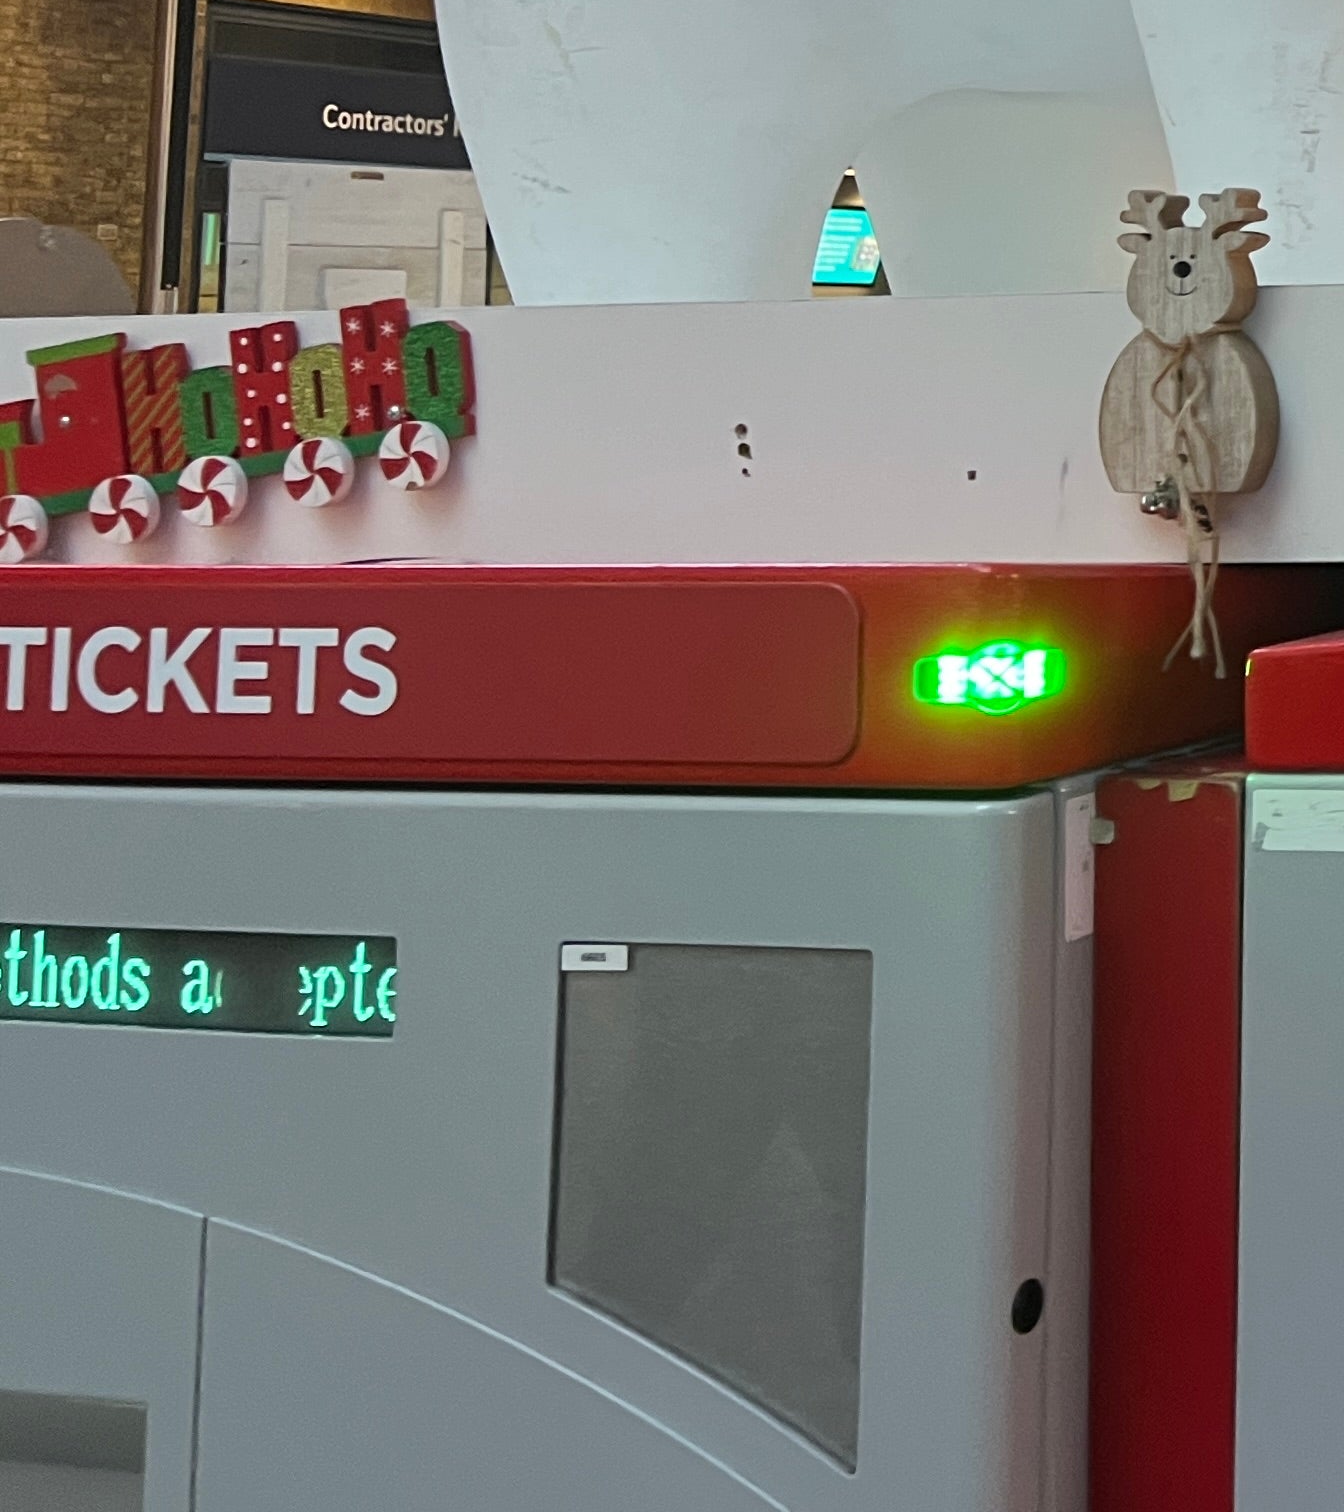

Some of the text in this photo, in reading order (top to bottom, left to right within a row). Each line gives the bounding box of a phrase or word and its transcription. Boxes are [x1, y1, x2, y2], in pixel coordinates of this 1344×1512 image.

[322, 103, 449, 136] Contractors'
[0, 626, 399, 715] TICKETS
[0, 929, 151, 1011] thods
